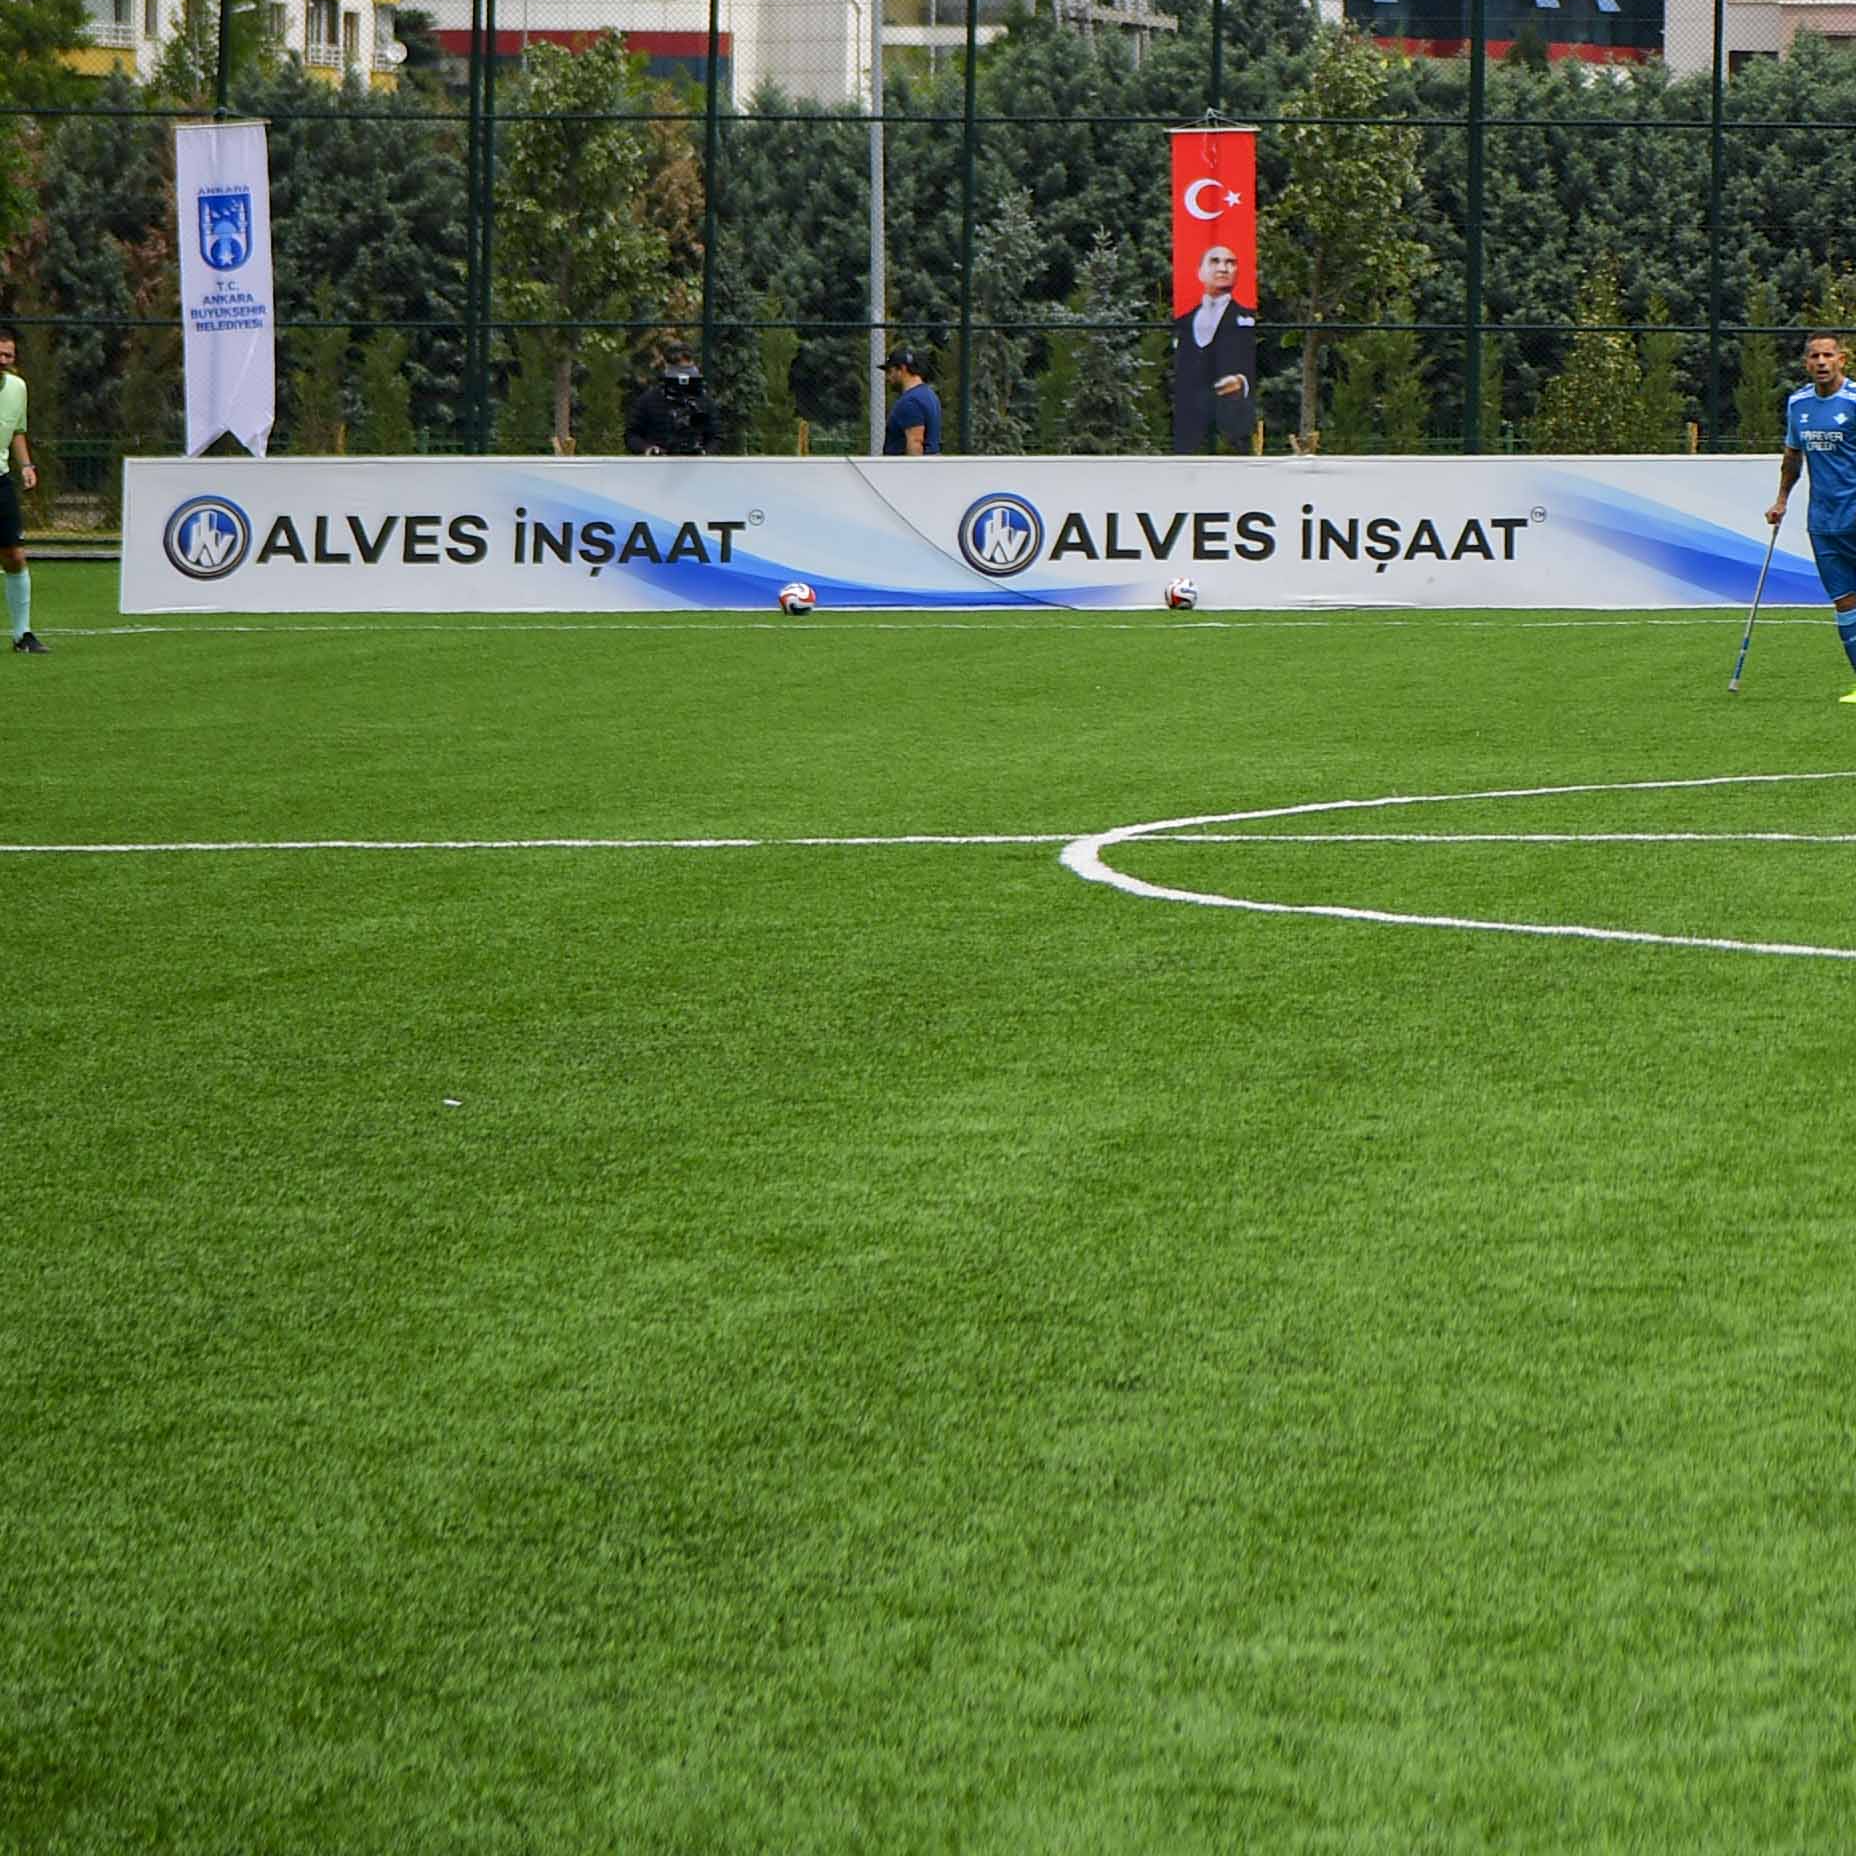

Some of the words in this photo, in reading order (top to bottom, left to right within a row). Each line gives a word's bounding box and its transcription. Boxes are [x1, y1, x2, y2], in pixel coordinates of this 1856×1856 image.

[202, 293, 254, 305] ANKARA
[255, 514, 487, 565] ALVES
[1048, 511, 1276, 561] ALVES
